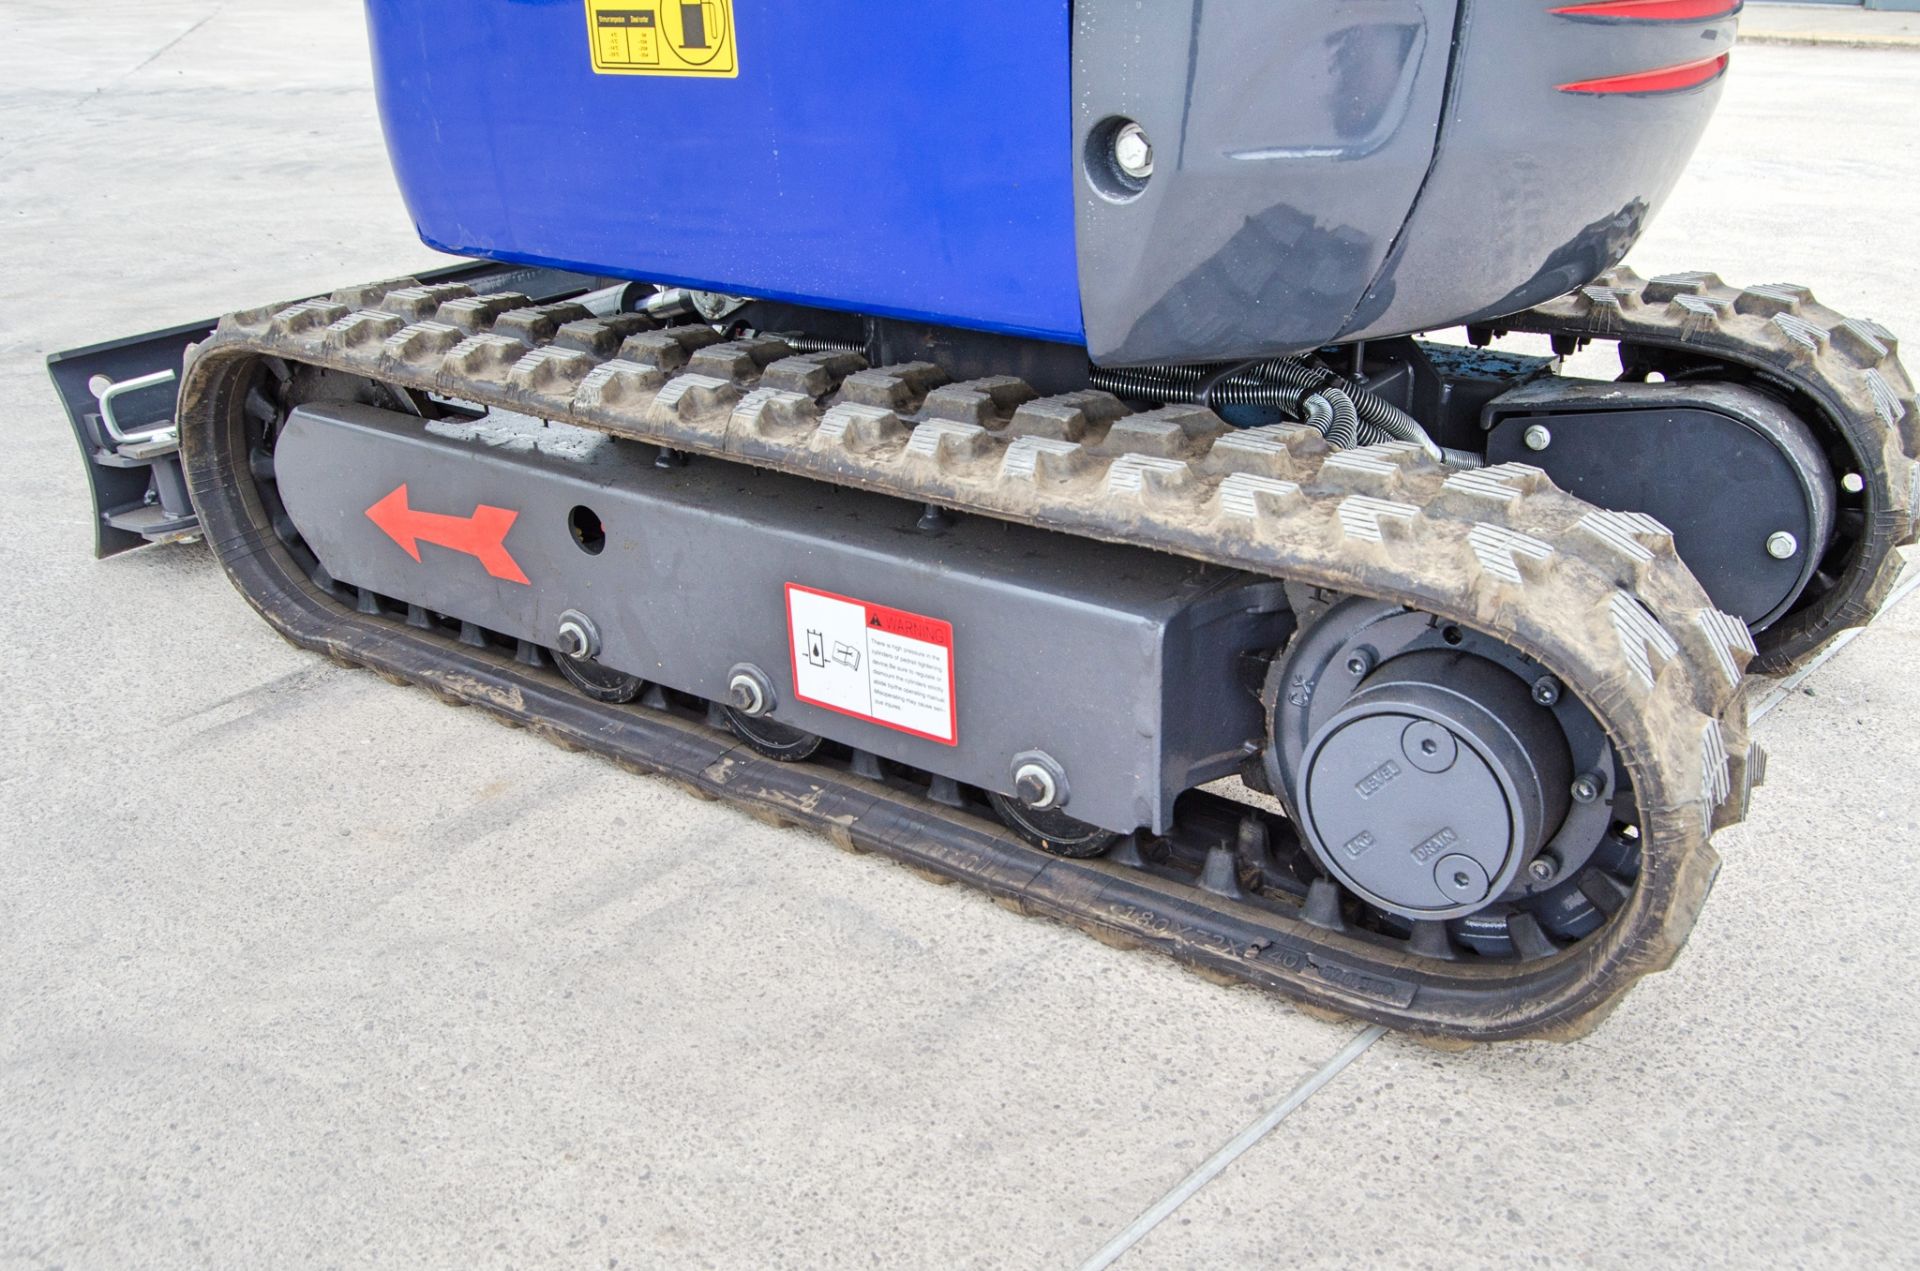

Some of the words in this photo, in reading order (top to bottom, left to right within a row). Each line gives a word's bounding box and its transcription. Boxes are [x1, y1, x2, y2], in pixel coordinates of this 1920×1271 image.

[872, 638, 885, 647] There
[886, 619, 945, 643] WARNING
[1357, 761, 1401, 797] LEVEL
[1415, 827, 1457, 862] DRAIN
